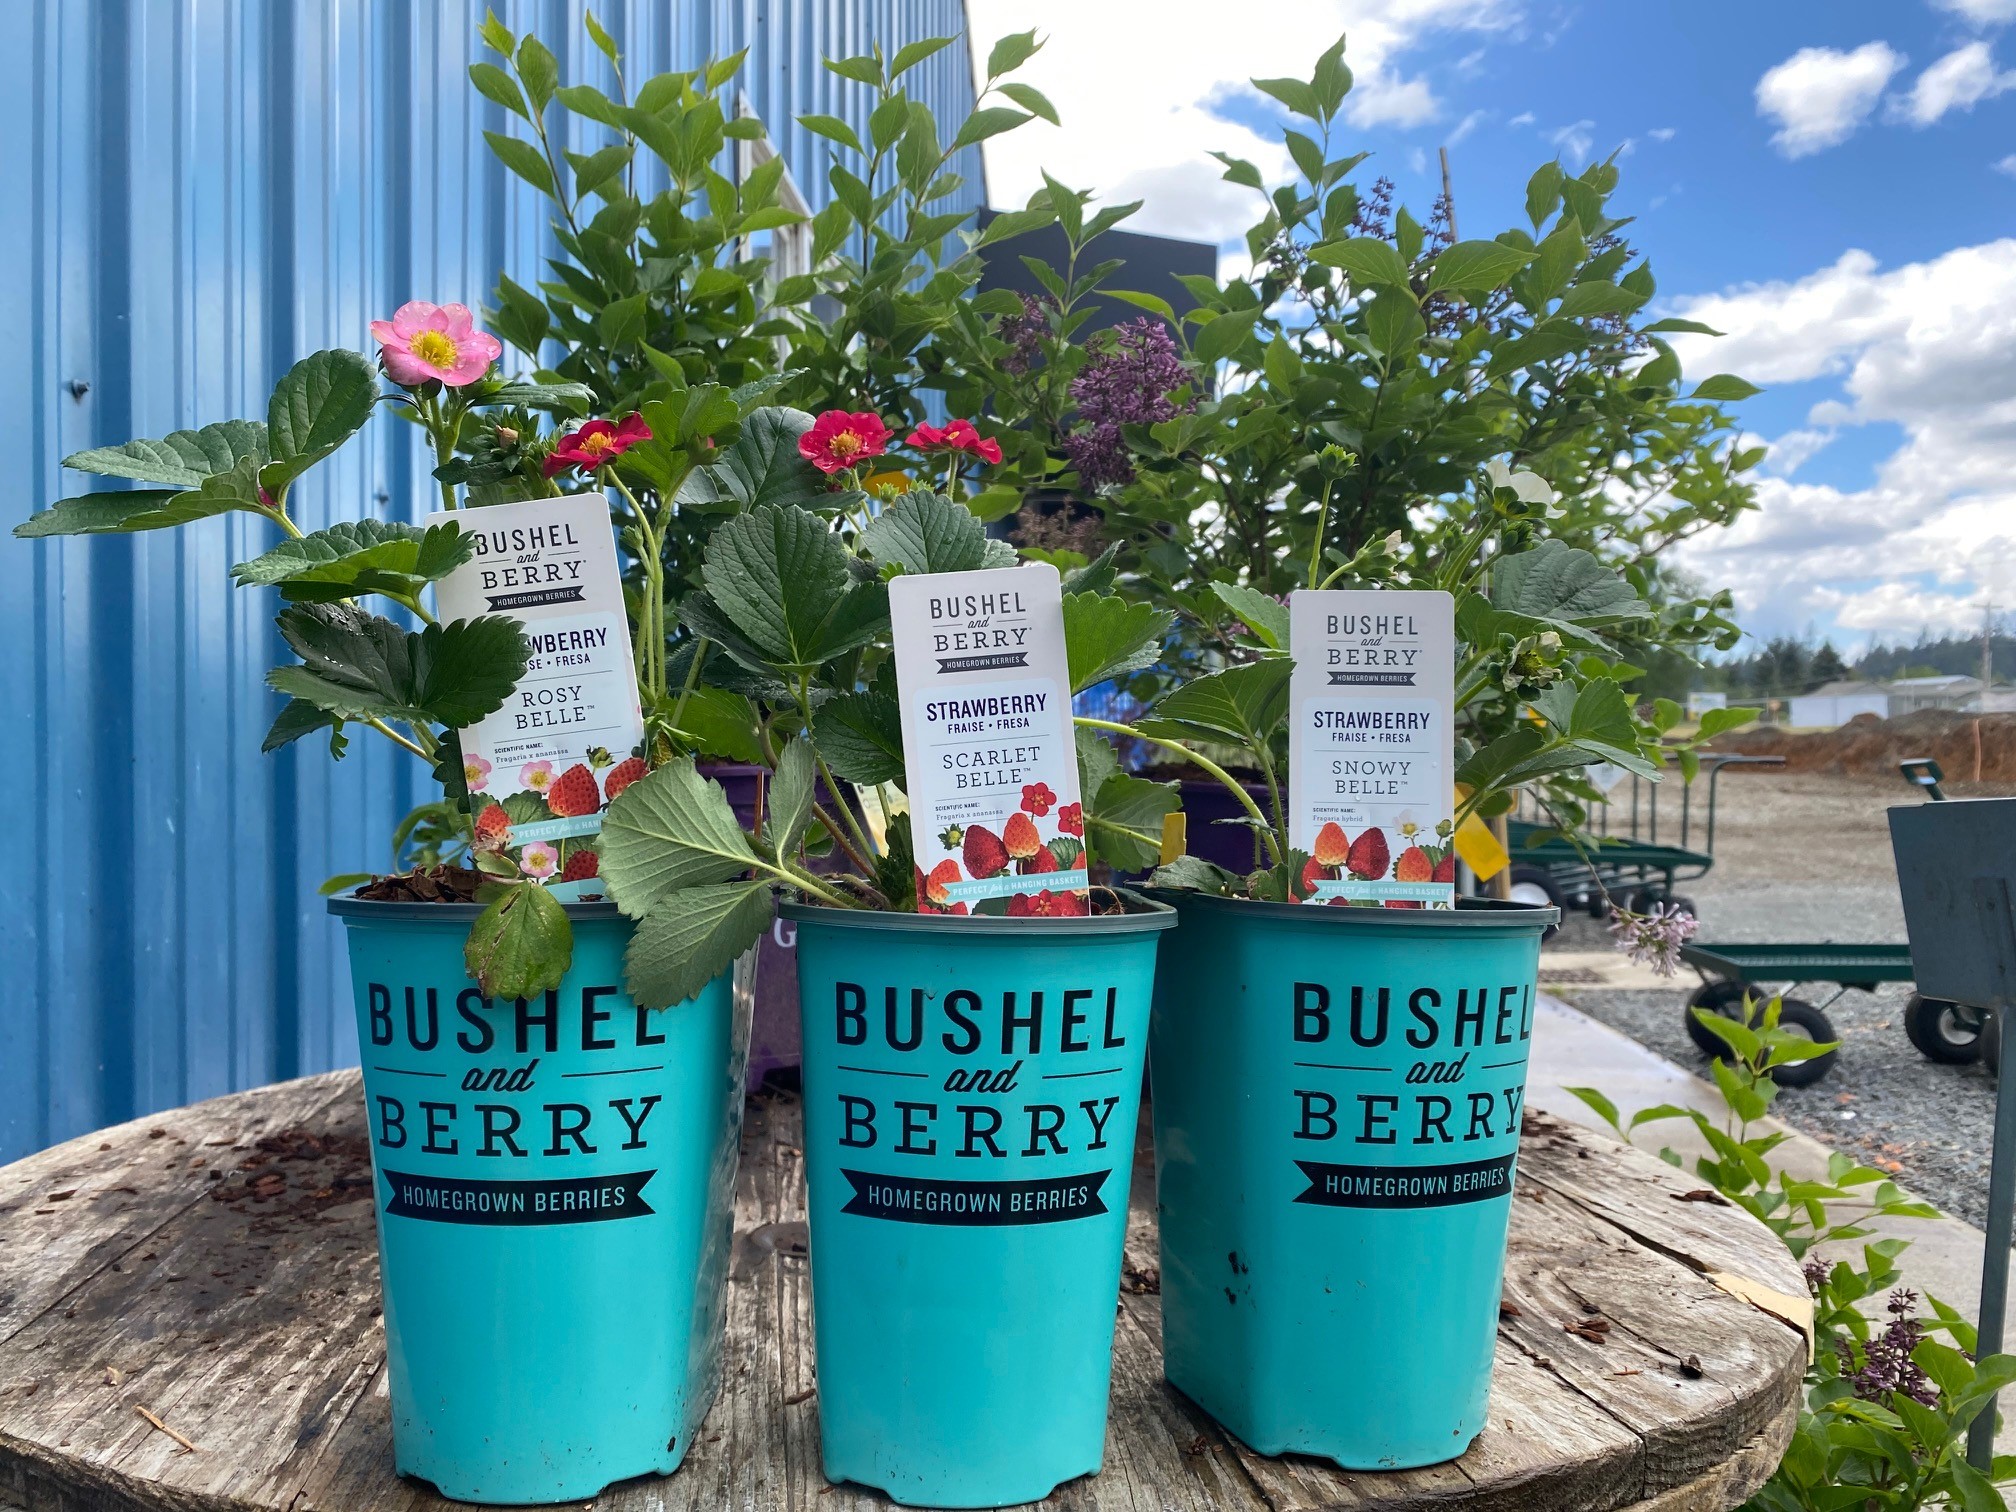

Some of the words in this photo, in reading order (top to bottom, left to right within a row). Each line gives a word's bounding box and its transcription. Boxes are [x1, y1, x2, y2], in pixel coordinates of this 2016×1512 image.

[474, 523, 579, 556] BUSHEL
[516, 550, 540, 564] and
[481, 560, 582, 590] BERRY
[497, 593, 544, 606] HOMEGROWN
[545, 590, 576, 601] BERRIES
[930, 592, 1026, 619] BUSHEL
[968, 617, 990, 629] and
[1327, 615, 1418, 635] BUSHEL
[934, 628, 1027, 652] BERRY
[1361, 636, 1383, 646] and
[555, 653, 591, 667] FRESA
[946, 658, 990, 669] HOMEGROWN
[992, 656, 1020, 665] BERRIES
[1327, 649, 1418, 666] BERRY
[1337, 674, 1379, 682] HOMEGROWN
[521, 685, 582, 708] ROSY
[926, 693, 1047, 722] STRAWBERRY
[948, 722, 984, 734] FRAISE
[997, 718, 1030, 729] FRESA
[1314, 711, 1430, 730] STRAWBERRY
[494, 744, 524, 754] SCIENTIFIC
[525, 742, 544, 750] NAME:
[1332, 732, 1367, 742] FRAISE
[1379, 733, 1411, 743] FRESA
[496, 754, 527, 763] Fragaria
[535, 749, 569, 758] ananassa
[943, 746, 1040, 770] SCARLET
[1332, 760, 1411, 776] SNOWY
[973, 809, 1003, 817] ananassa
[1341, 815, 1363, 823] hybrid
[518, 826, 557, 838] PERFECT
[953, 885, 987, 896] PERFECT
[1011, 880, 1047, 890] HANGING
[1049, 875, 1082, 886] BASKET!
[1321, 885, 1355, 894] PERFECT
[1378, 887, 1413, 895] HANGING
[368, 982, 666, 1054] BUSHEL
[835, 981, 1126, 1055] BUSHEL
[1293, 981, 1530, 1050] BUSHEL
[461, 1058, 541, 1092] and
[943, 1060, 1024, 1093] and
[1405, 1052, 1470, 1084] and
[1293, 1085, 1524, 1145] BERRY
[376, 1095, 662, 1158] BERRY
[837, 1094, 1120, 1158] BERRY
[1326, 1175, 1448, 1197] HOMEGROWN
[1453, 1166, 1505, 1194] BERRIES
[403, 1185, 525, 1212] HOMEGROWN
[535, 1187, 626, 1212] BERRIES
[869, 1185, 1001, 1213] HOMEGROWN
[1010, 1186, 1088, 1212] BERRIES
